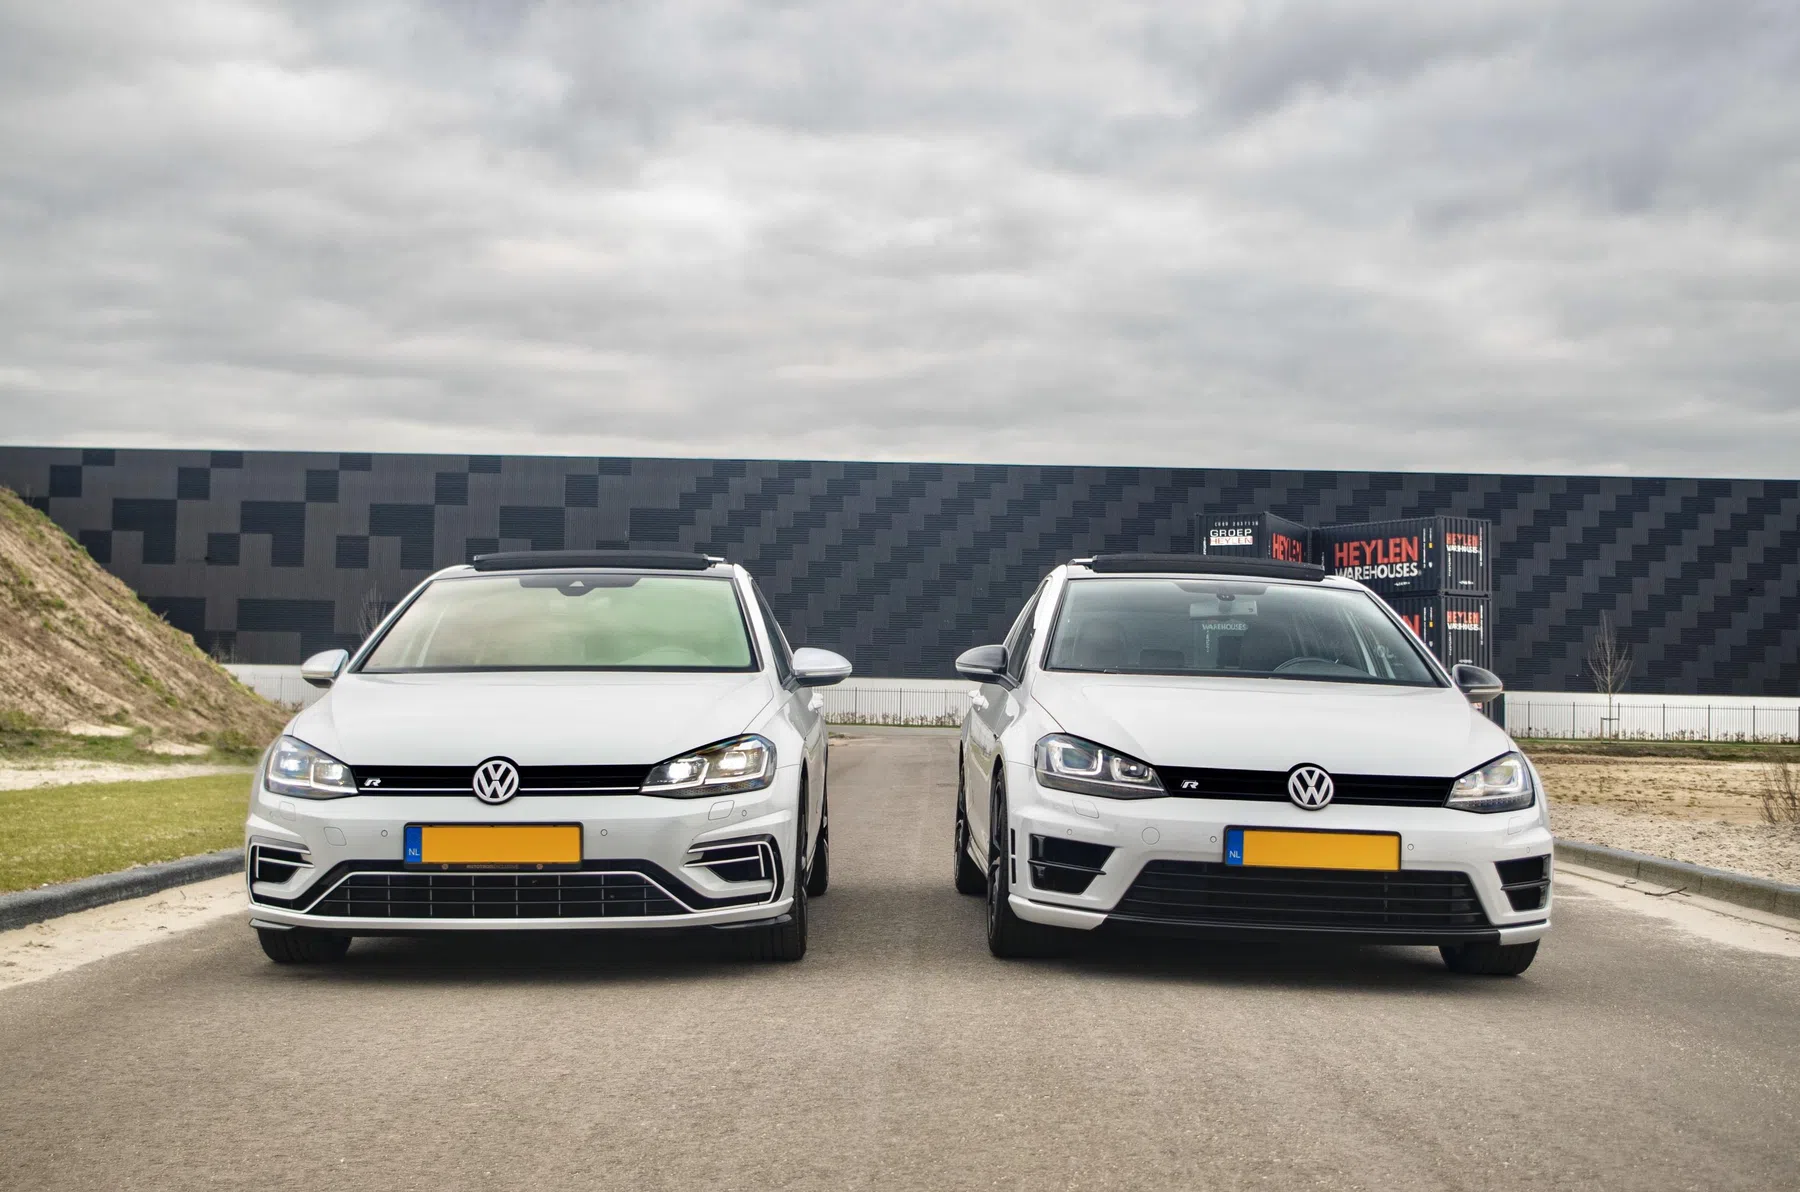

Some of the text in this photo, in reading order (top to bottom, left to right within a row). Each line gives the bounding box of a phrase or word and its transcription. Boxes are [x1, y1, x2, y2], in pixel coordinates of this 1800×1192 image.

[1210, 529, 1252, 537] GROEP
[1446, 532, 1479, 546] HEYLEN
[1209, 537, 1253, 545] HEYLEN
[1272, 533, 1302, 563] HEYLEN
[1334, 536, 1419, 567] HEYLEN
[1335, 562, 1419, 580] WAREHOUSES
[1446, 610, 1480, 624] HEYLEN
[364, 778, 381, 787] R
[473, 760, 519, 802] VW
[1181, 780, 1199, 789] R
[1288, 766, 1334, 808] VW
[408, 848, 421, 856] NL
[1229, 850, 1241, 859] NL
